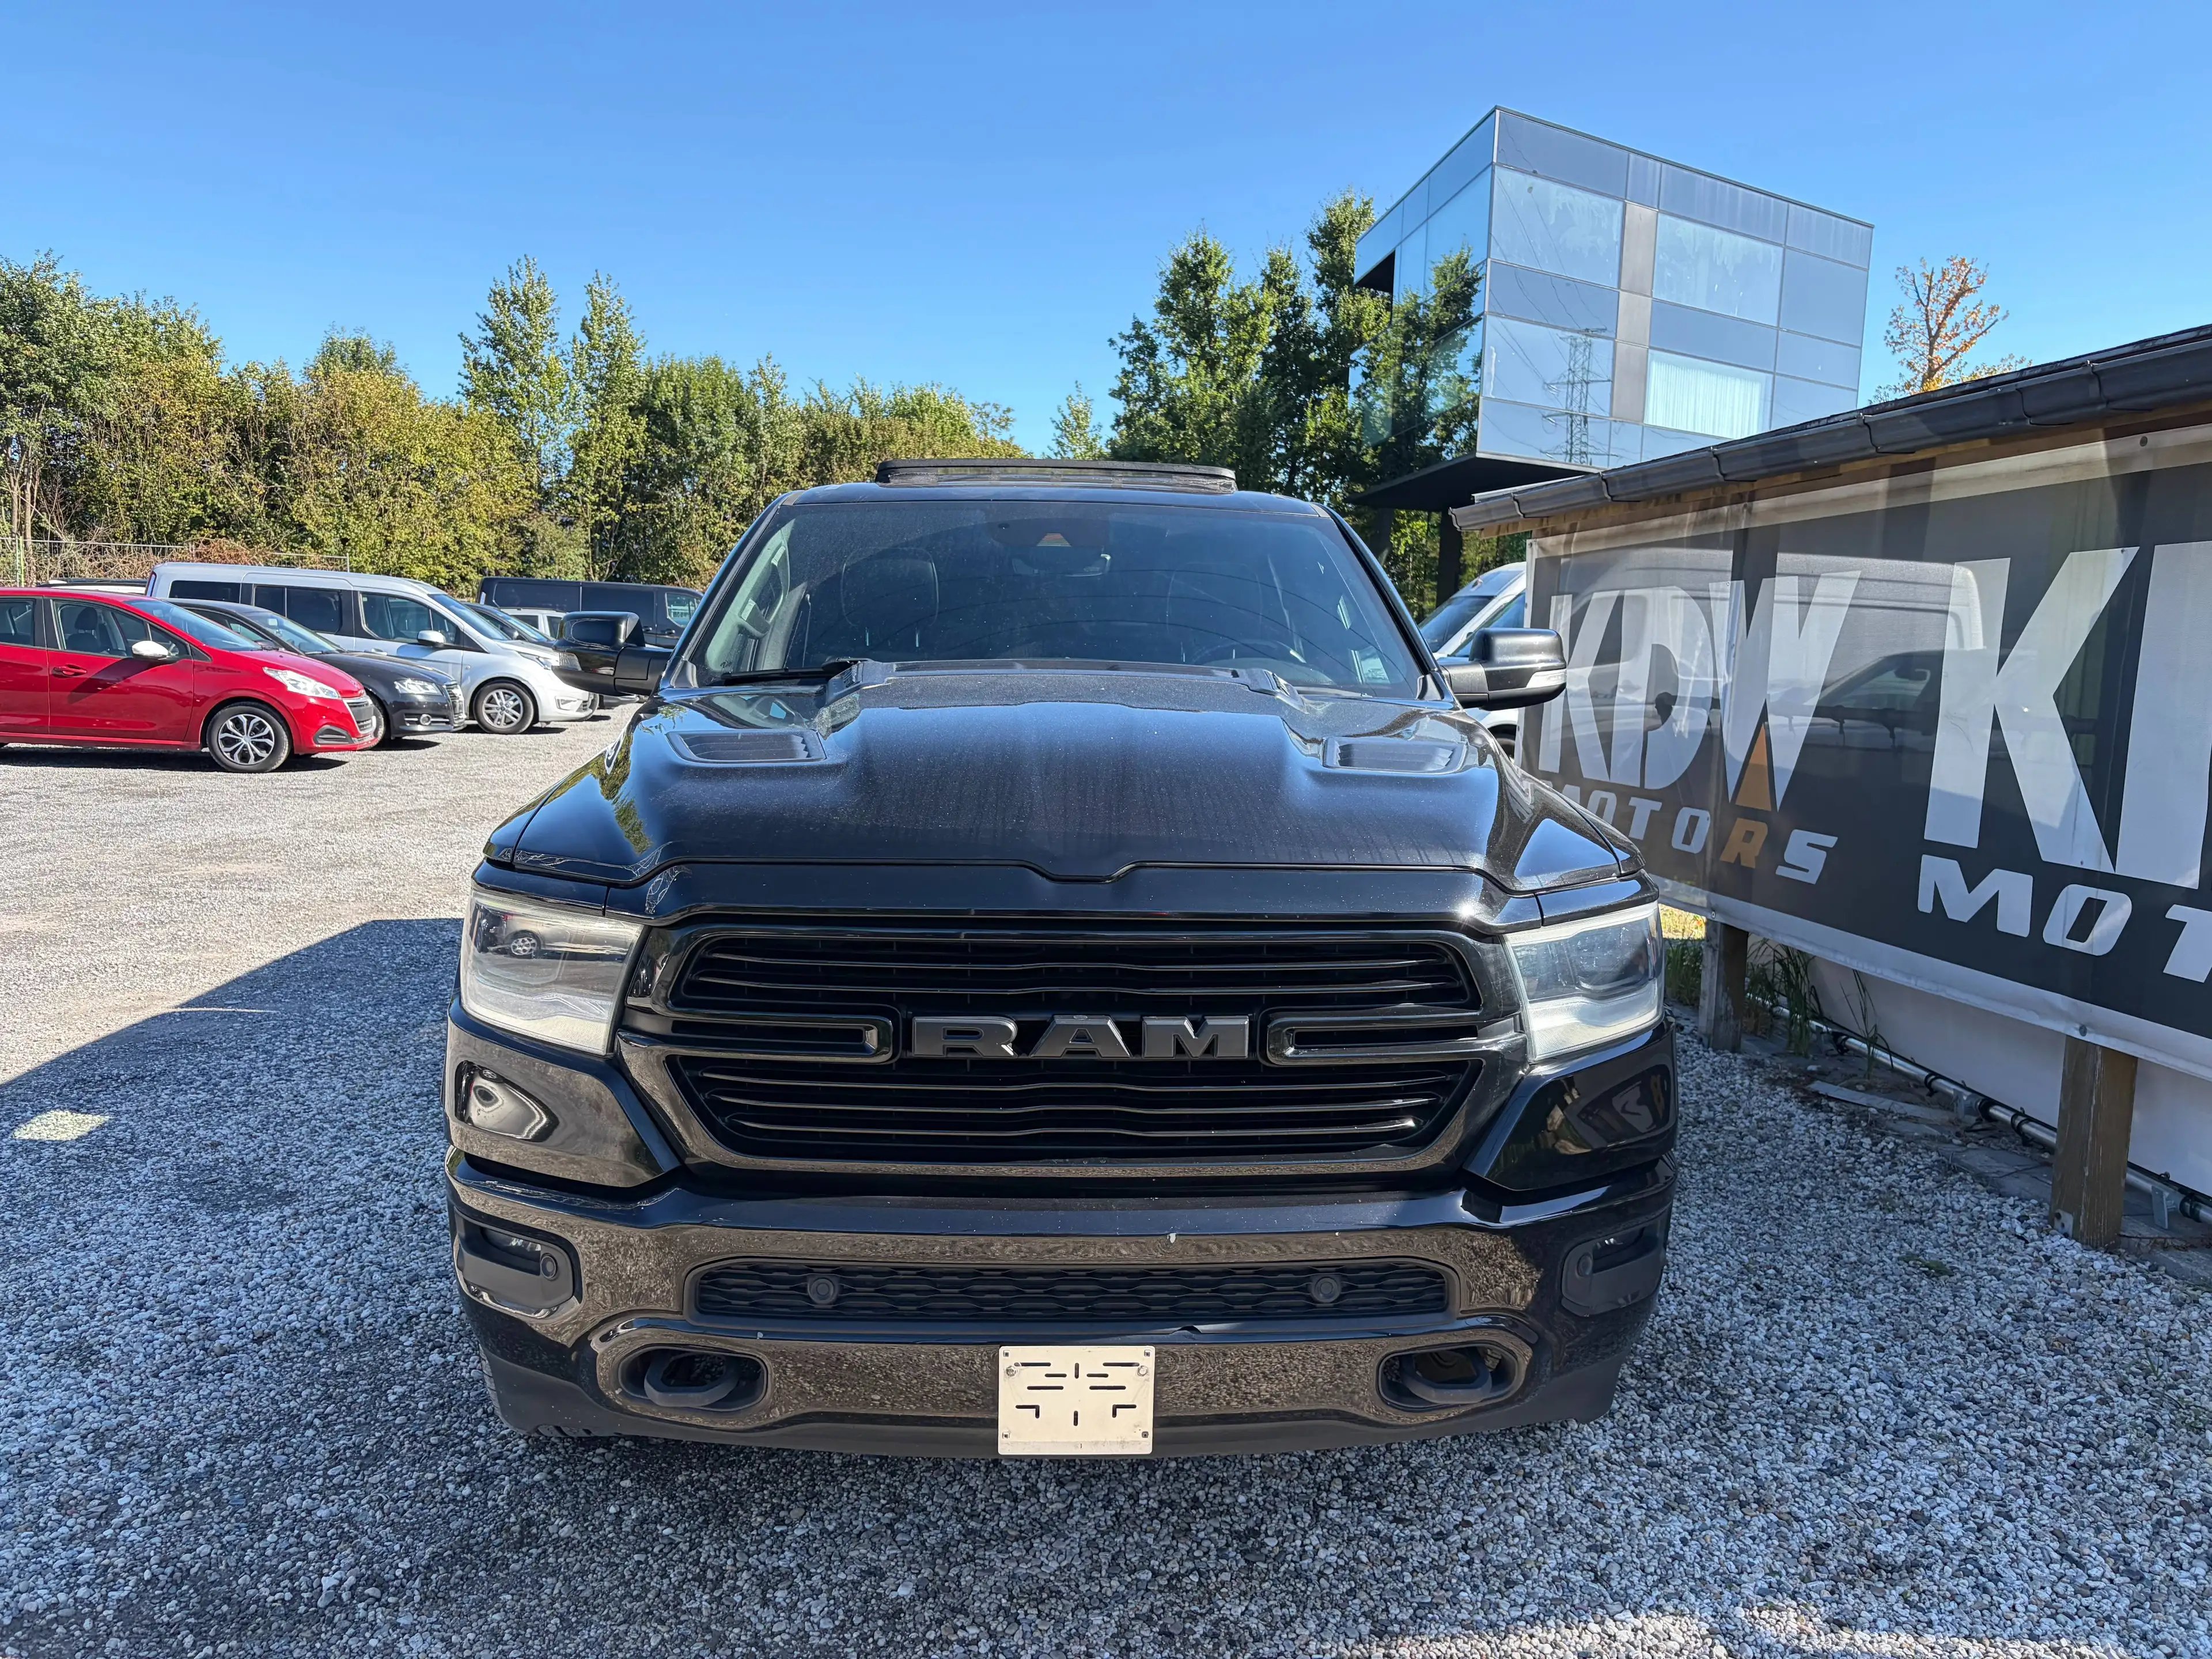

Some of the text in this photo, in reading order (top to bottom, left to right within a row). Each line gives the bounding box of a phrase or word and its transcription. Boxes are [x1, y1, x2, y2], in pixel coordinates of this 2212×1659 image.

[1539, 570, 1861, 812] KDW
[1540, 779, 1838, 885] OTORS
[912, 1015, 1249, 1058] RAM
